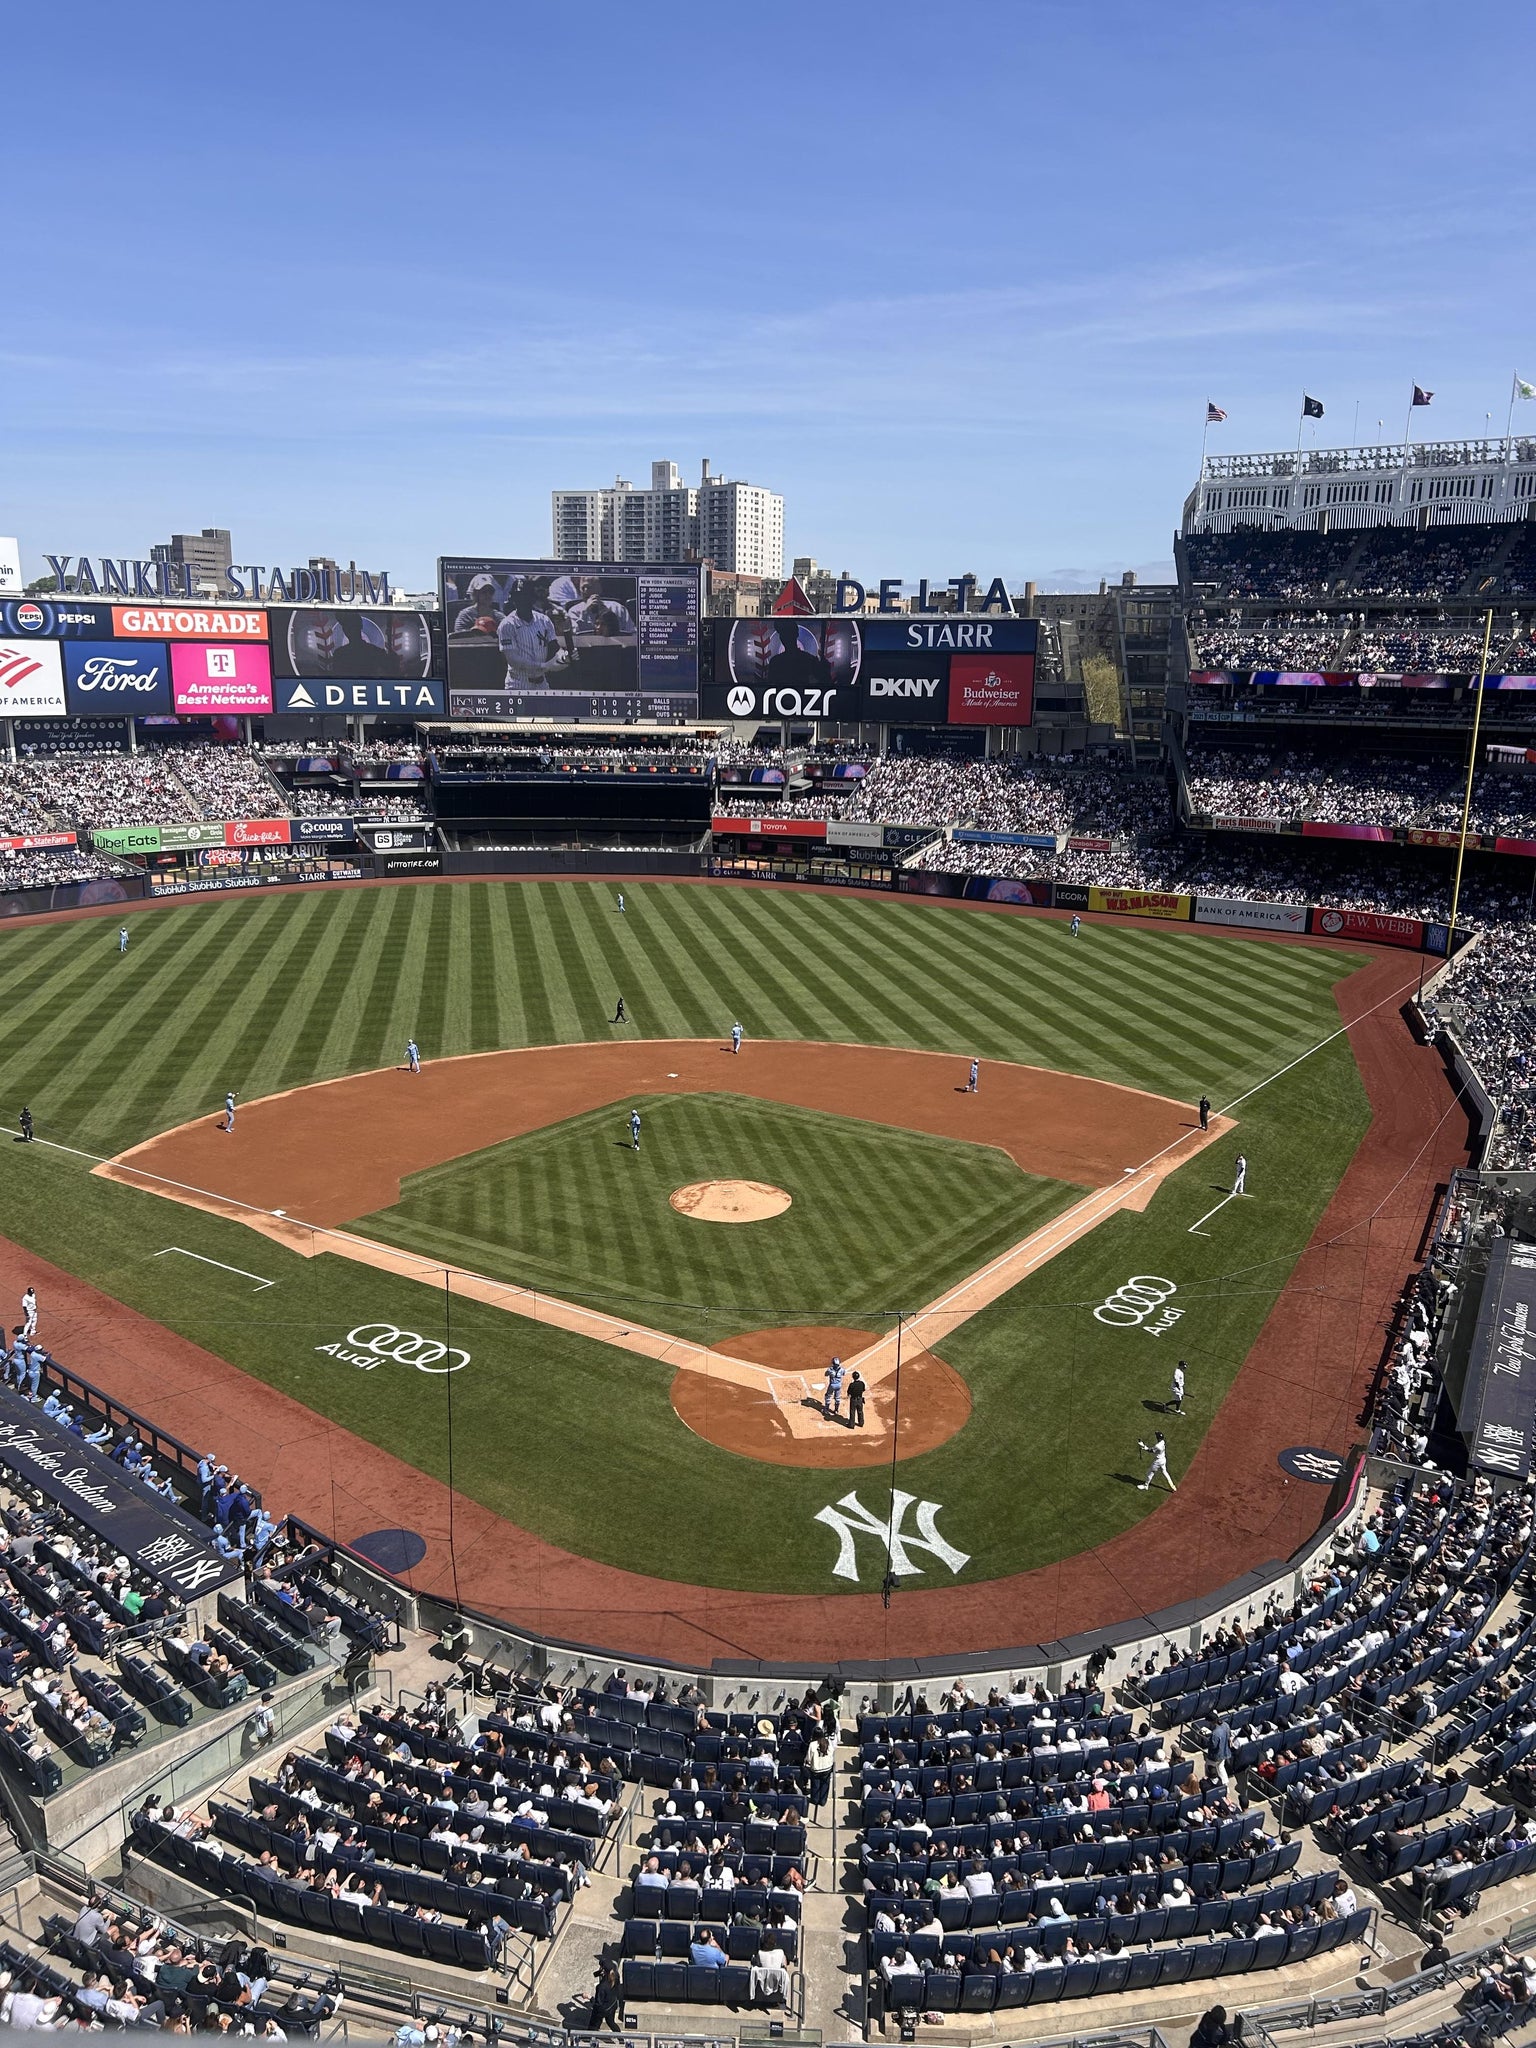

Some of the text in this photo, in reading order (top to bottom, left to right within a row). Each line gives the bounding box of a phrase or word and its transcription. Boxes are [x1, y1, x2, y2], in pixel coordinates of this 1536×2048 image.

[42, 554, 391, 606] YANKEE STADIUM
[836, 577, 1015, 613] DELTA
[19, 613, 42, 621] PEPSI
[58, 614, 96, 625] PEPSI
[122, 610, 261, 635] GATORADE
[906, 623, 993, 648] STARR
[77, 657, 159, 692] Ford
[187, 683, 258, 694] America's
[869, 677, 940, 698] DKNY
[963, 687, 1020, 699] Budweiser
[12, 697, 63, 705] AMERICA
[177, 694, 269, 705] Best Network
[325, 685, 436, 706] DELTA
[762, 688, 837, 716] razr
[495, 702, 501, 710] 2
[961, 699, 983, 707] Made
[508, 707, 514, 715] 0
[313, 823, 343, 832] coupa
[1215, 818, 1277, 829] Parts Authority
[97, 838, 126, 849] Uber
[128, 835, 158, 847] Eats
[377, 834, 390, 844] GS
[1069, 840, 1094, 848] Reebok
[252, 847, 262, 862] A
[849, 849, 889, 862] StubHub
[387, 859, 439, 869] NITTOTIRE.COM
[299, 872, 326, 882] STARR
[751, 870, 777, 880] STARR
[154, 877, 260, 896] StubHub StubHub StubHub
[1056, 891, 1088, 902] LEGORA
[1197, 906, 1223, 915] BANK
[1238, 910, 1282, 921] AMERICA
[1374, 917, 1415, 935] WEBB
[1143, 1306, 1187, 1337] Audi
[314, 1343, 387, 1371] Audi
[2, 1429, 66, 1470] Yankee
[52, 1467, 117, 1513] Stadium
[813, 1487, 972, 1582] NY
[149, 1536, 184, 1562] YORK
[161, 1533, 194, 1554] NEW
[136, 1545, 163, 1566] LIFE
